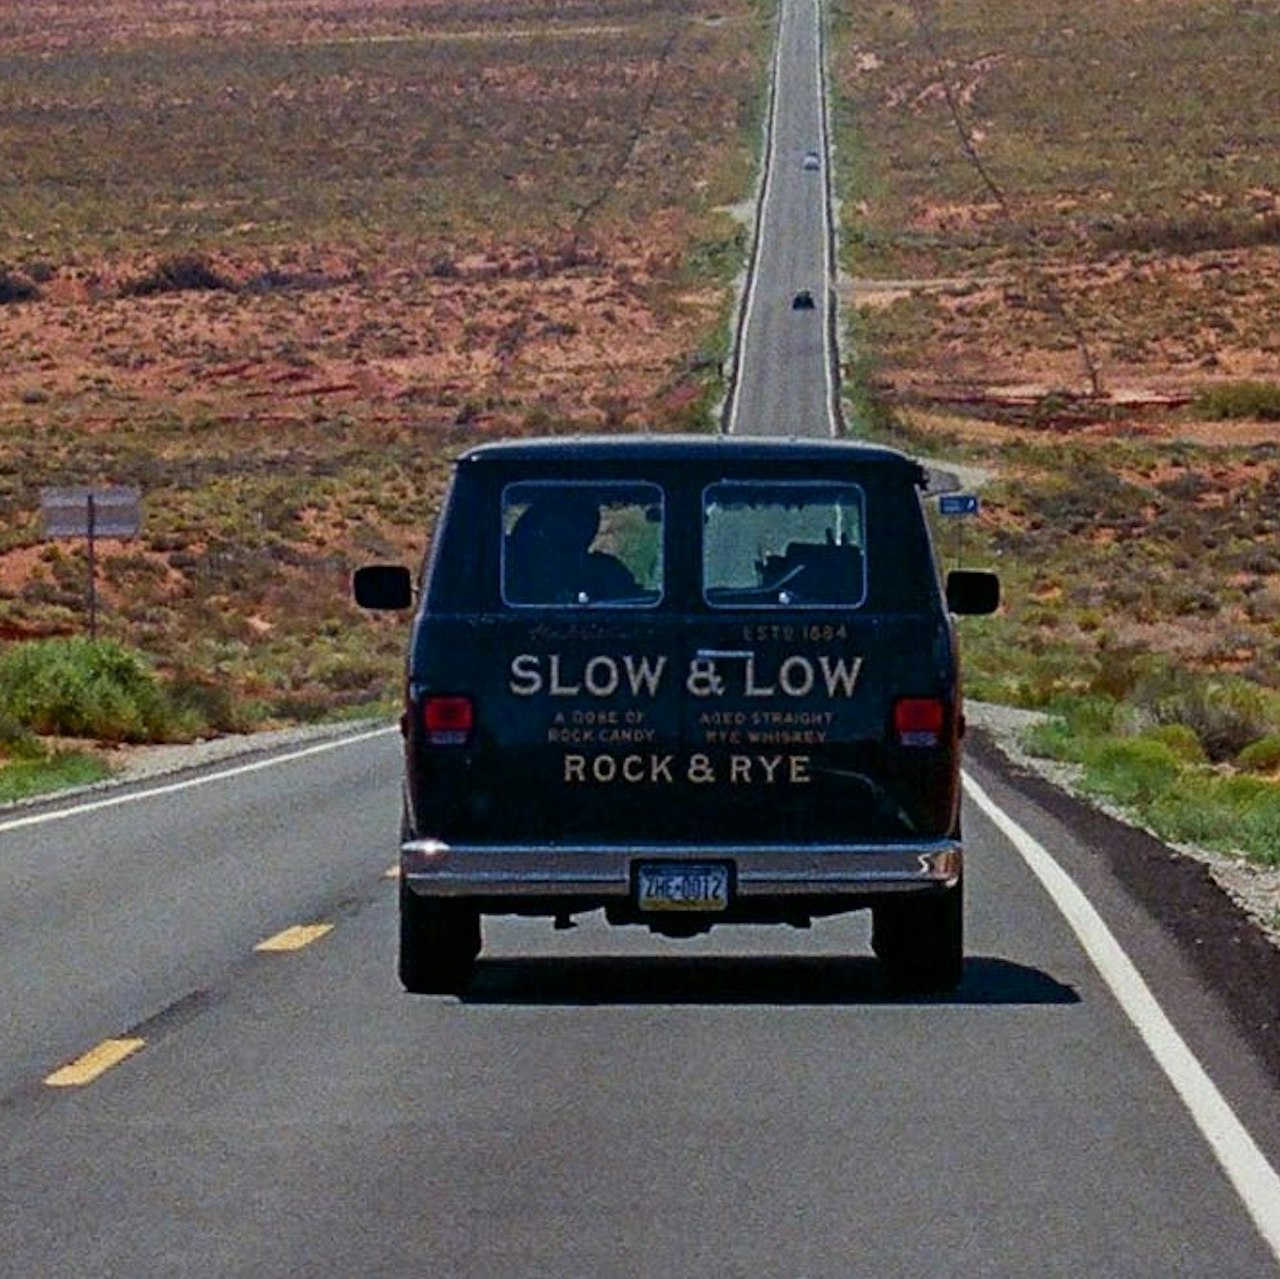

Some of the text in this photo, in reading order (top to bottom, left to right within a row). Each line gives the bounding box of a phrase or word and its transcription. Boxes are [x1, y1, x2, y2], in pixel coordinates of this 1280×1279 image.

[509, 654, 865, 698] SLOW & LOW
[751, 711, 834, 725] STRAIGHT
[548, 727, 656, 743] ROCK CANDY
[563, 753, 812, 783] ROCK & RYE
